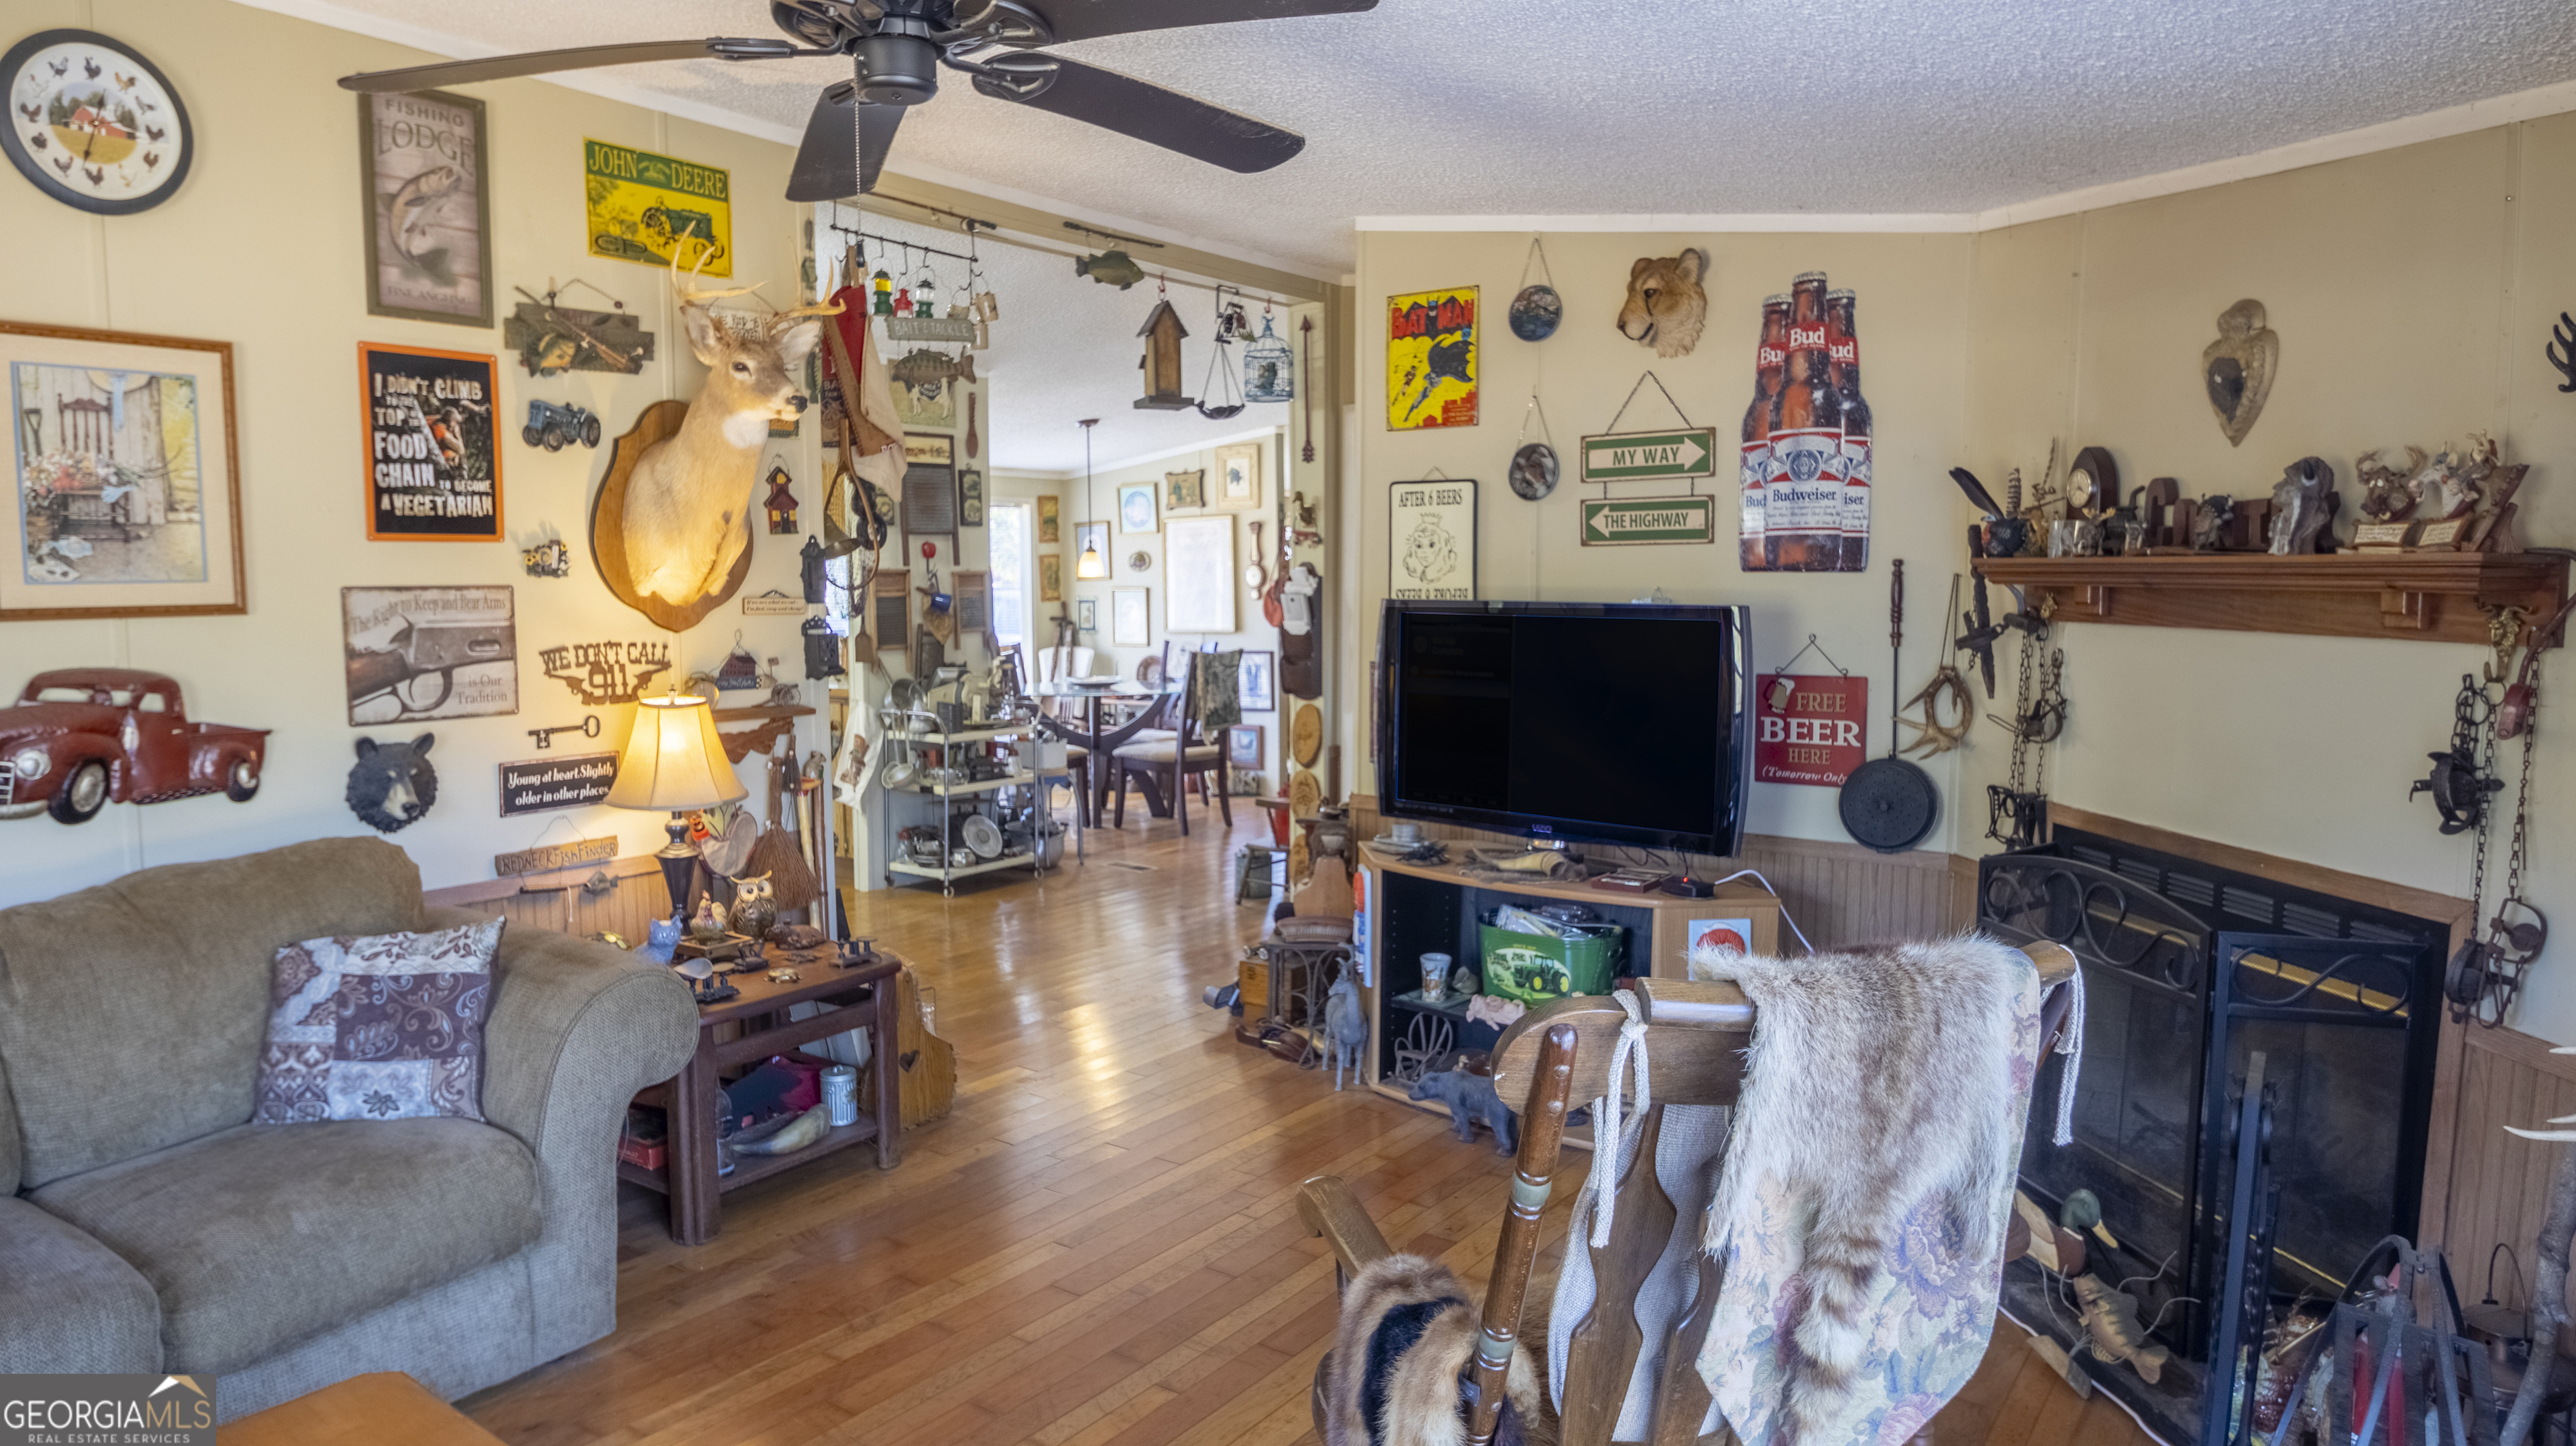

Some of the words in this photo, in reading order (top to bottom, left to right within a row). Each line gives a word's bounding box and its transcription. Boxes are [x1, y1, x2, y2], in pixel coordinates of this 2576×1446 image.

[386, 99, 464, 127] FISHING
[377, 118, 474, 176] LODGE
[589, 144, 637, 179] JOHN
[671, 162, 726, 199] DEERE
[893, 320, 920, 336] BAIT
[930, 322, 970, 336] TACKLE
[1391, 298, 1474, 340] BATMAN
[1789, 326, 1826, 347] Bud
[374, 372, 382, 398] I
[434, 377, 482, 400] CLIMB
[375, 408, 405, 426] TOP
[374, 431, 428, 460] FOOD
[1613, 449, 1637, 466] MY
[1643, 446, 1680, 464] WAY
[375, 463, 435, 488] CHAIN
[439, 479, 451, 490] TO
[454, 480, 492, 492] BECOME
[381, 493, 391, 510] A
[392, 494, 493, 518] VEGETARIAN
[1399, 491, 1426, 507] AFTER
[1428, 489, 1434, 506] 6
[1436, 489, 1462, 506] BEERS
[1773, 487, 1836, 502] Budweiser
[1603, 514, 1627, 529] THE
[1629, 512, 1689, 528] HIGHWAY
[351, 616, 370, 635] The
[373, 601, 399, 627] Right
[402, 600, 413, 613] to
[413, 594, 439, 616] Keep
[442, 594, 459, 611] and
[461, 594, 480, 611] Bear
[482, 594, 506, 610] Arms
[539, 646, 571, 671] WE
[574, 641, 622, 667] DON'T
[628, 642, 671, 665] CALL
[481, 674, 502, 687] Our
[589, 663, 631, 705] 911
[455, 690, 507, 705] Tradition
[1795, 692, 1846, 713] FREE
[1760, 716, 1861, 747] BEER
[1787, 747, 1831, 765] HERE
[508, 772, 541, 789] Young
[542, 770, 552, 783] at
[580, 761, 614, 779] Slightly
[1763, 764, 1820, 782] (Tomorrow
[515, 789, 542, 806] older
[543, 791, 553, 803] in
[553, 786, 579, 801] other
[502, 849, 553, 872] REDNECK
